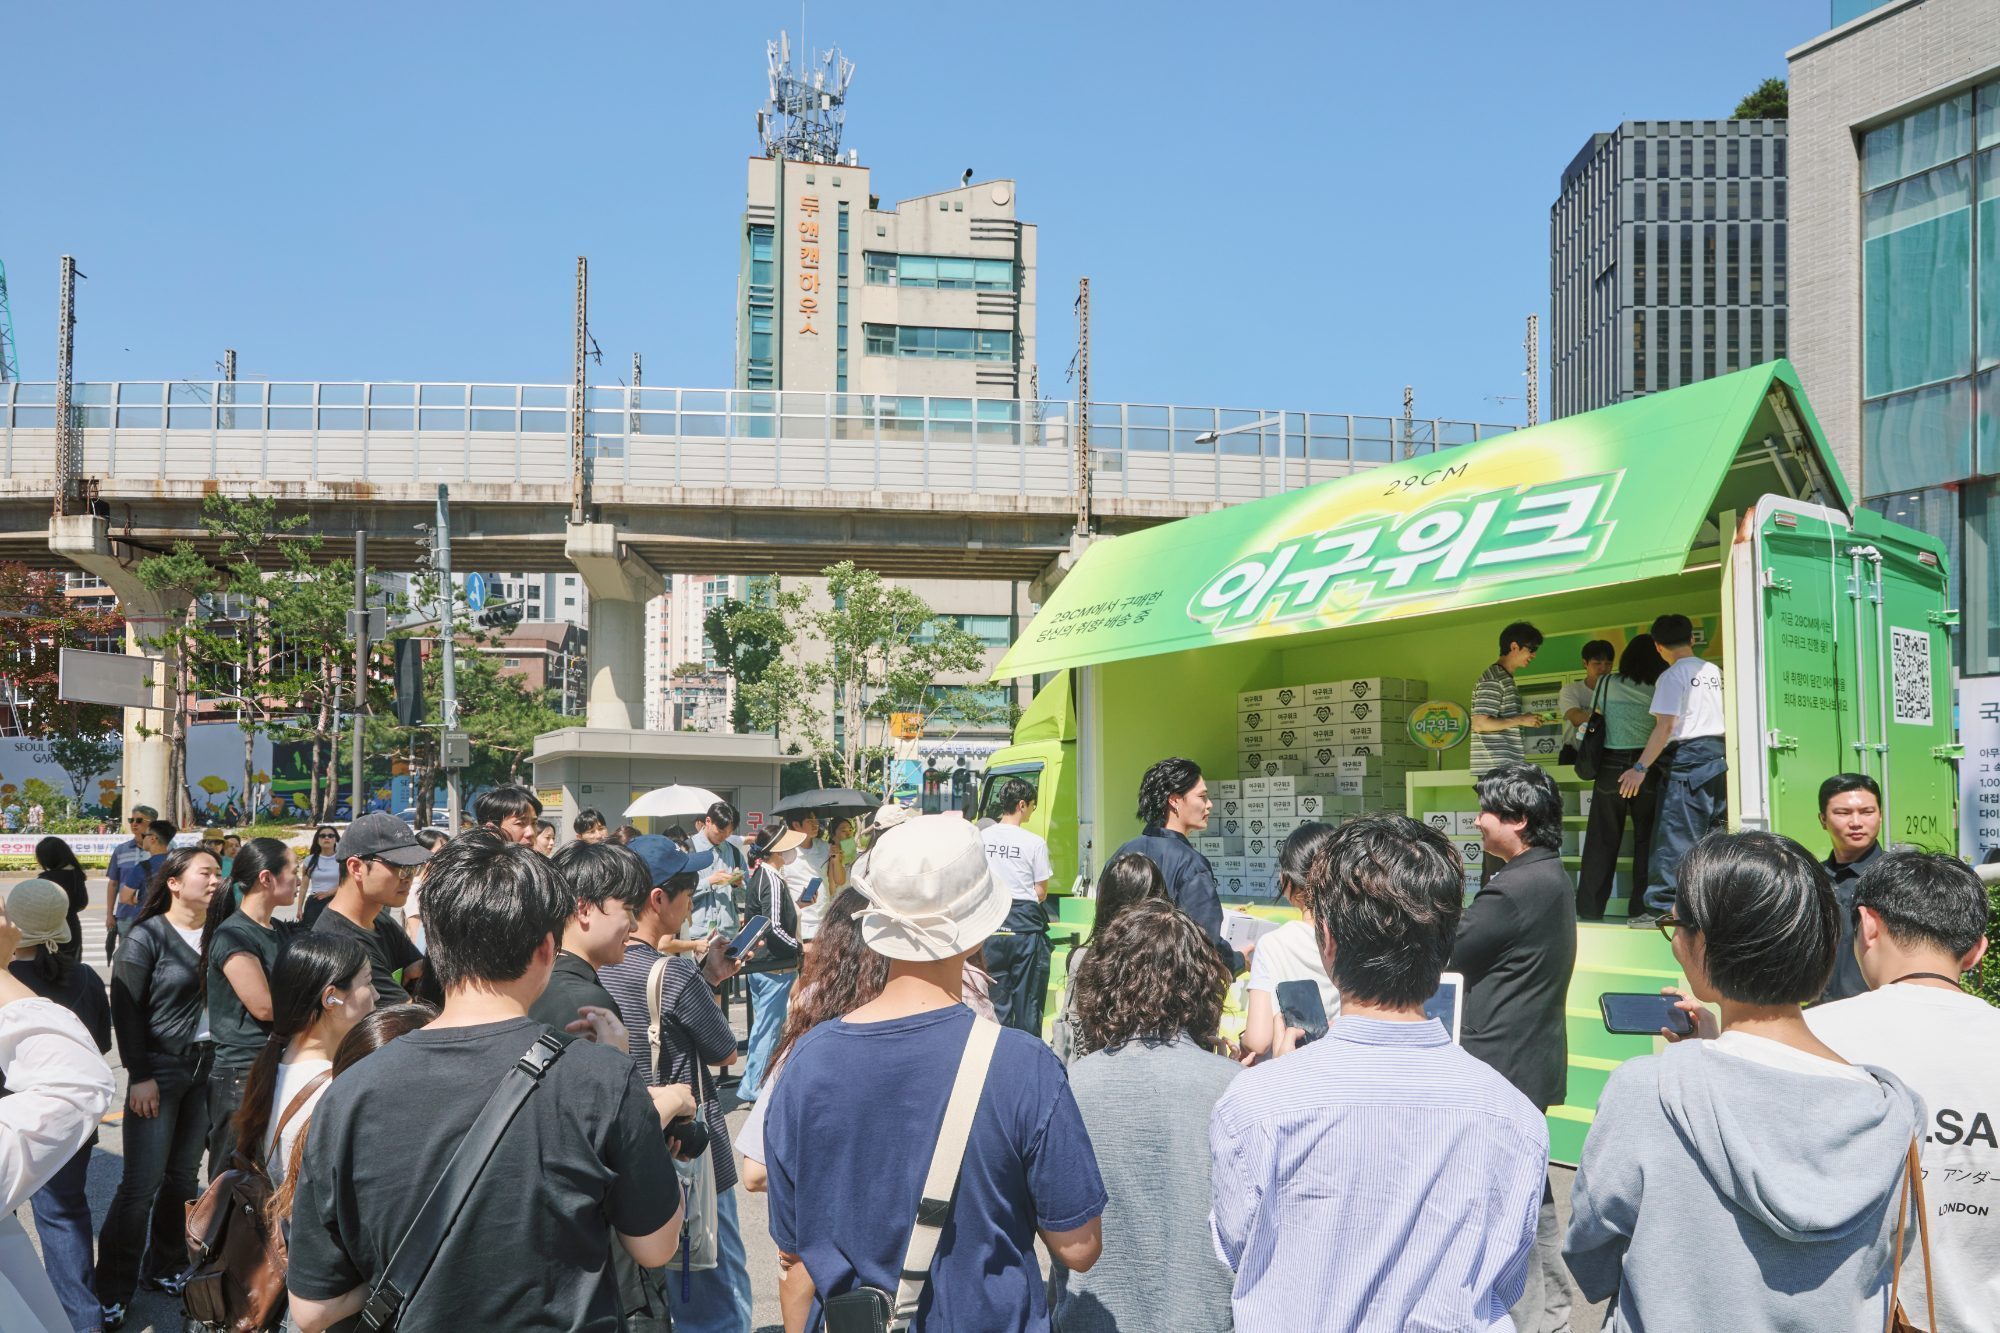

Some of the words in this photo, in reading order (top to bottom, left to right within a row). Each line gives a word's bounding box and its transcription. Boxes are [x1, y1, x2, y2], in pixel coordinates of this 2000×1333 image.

[1383, 462, 1469, 497] 29CM
[1200, 482, 1606, 619] 이구위크
[1050, 599, 1120, 624] 29CM에서
[1120, 590, 1164, 610] 구매한
[1036, 624, 1075, 643] 당신의
[1076, 617, 1105, 635] 취향
[1104, 613, 1132, 629] 배송
[1133, 609, 1153, 624] 중
[1780, 612, 1793, 627] 지금
[1782, 633, 1806, 649] 이구위크
[1808, 638, 1819, 653] 진행
[1783, 671, 1790, 684] 내
[1791, 672, 1809, 687] 취향이
[1810, 674, 1822, 688] 담긴
[1531, 699, 1558, 707] 이구위크
[1784, 693, 1797, 707] 최대
[1797, 695, 1819, 709] 83%로
[1350, 727, 1372, 735] 이구위크
[1415, 719, 1459, 732] 이구위크
[1312, 730, 1334, 738] 이구위크
[15, 743, 46, 752] SEOUL
[1979, 763, 1990, 772] 그
[1979, 793, 2000, 804] 대접
[747, 812, 764, 836] 구
[1905, 815, 1938, 835] 29CM
[1939, 1203, 1989, 1217] LONDON
